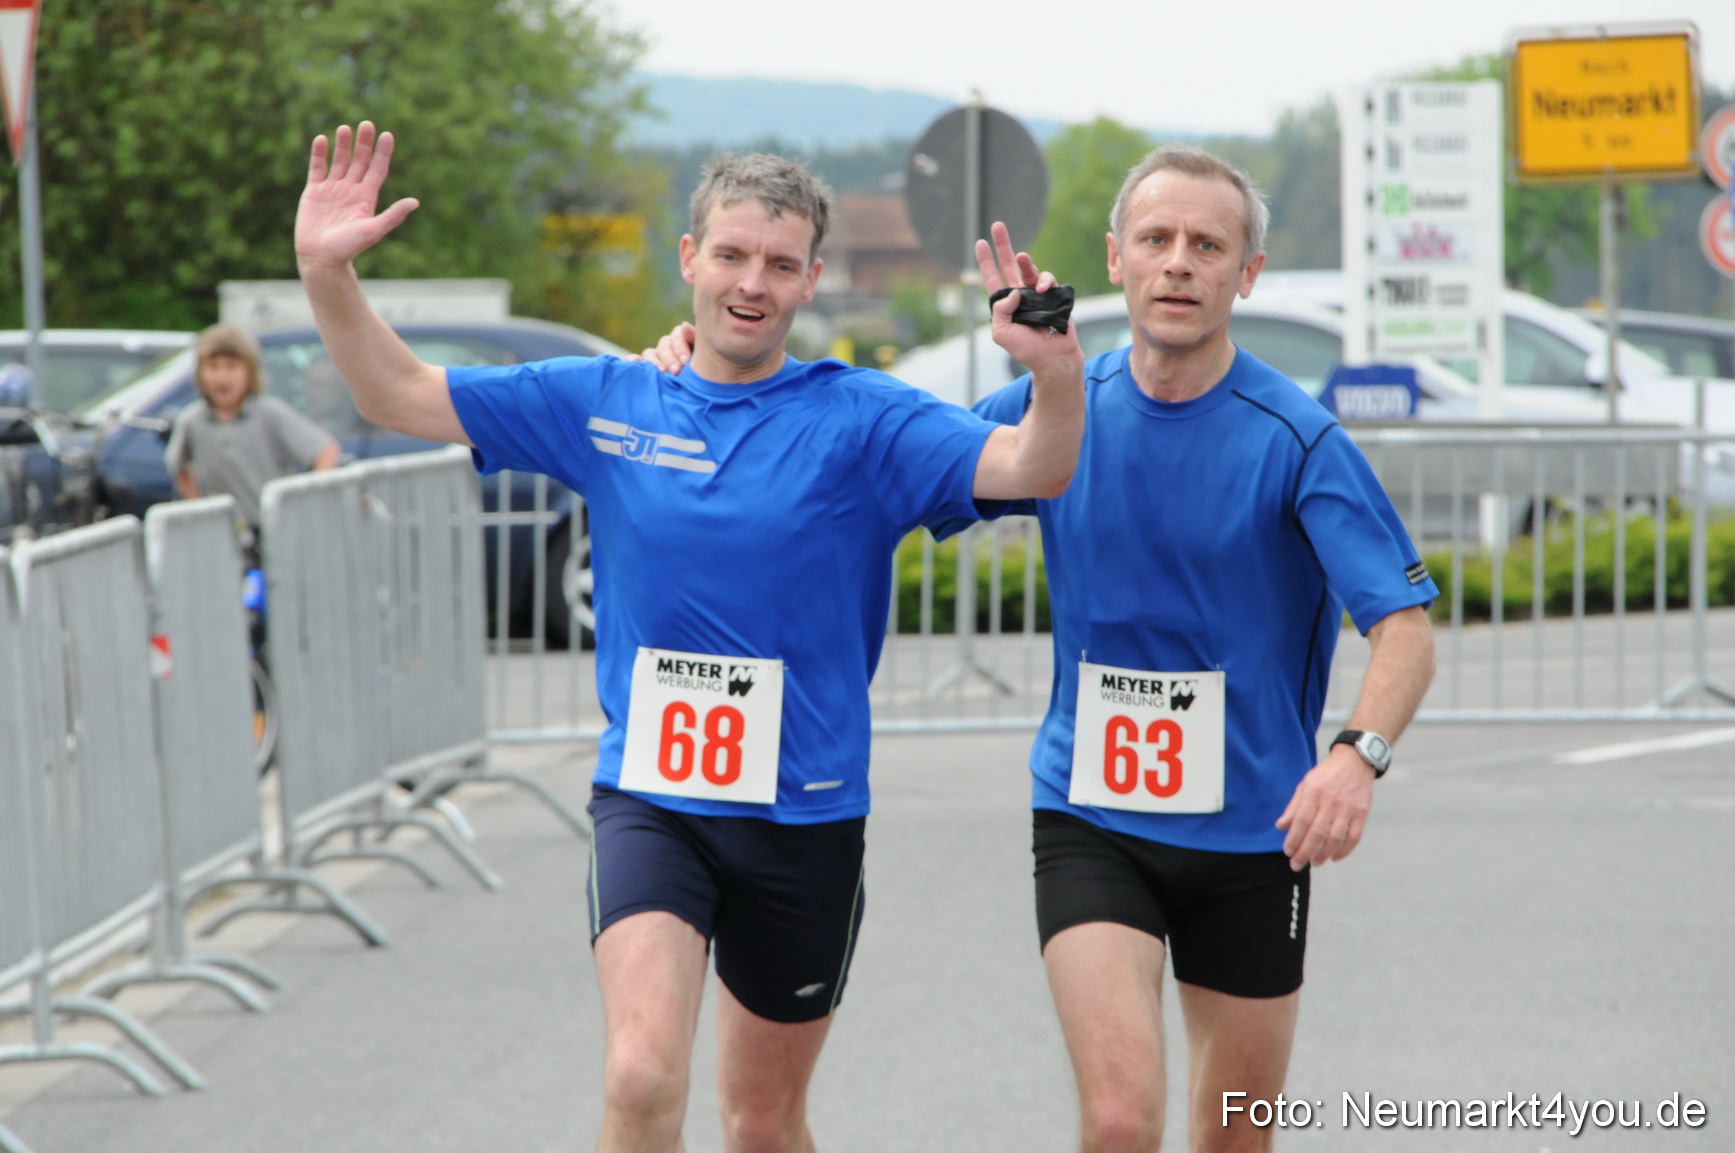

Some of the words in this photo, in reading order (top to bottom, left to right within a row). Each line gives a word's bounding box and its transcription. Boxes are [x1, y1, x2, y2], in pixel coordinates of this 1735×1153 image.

[1532, 84, 1677, 119] Neumarkt
[656, 657, 722, 679] MEYER
[656, 674, 723, 692] WERBUNG
[1101, 673, 1163, 695] MEYER
[1101, 690, 1165, 708] WERBUNG
[657, 701, 745, 786] 68
[1103, 715, 1183, 798] 63
